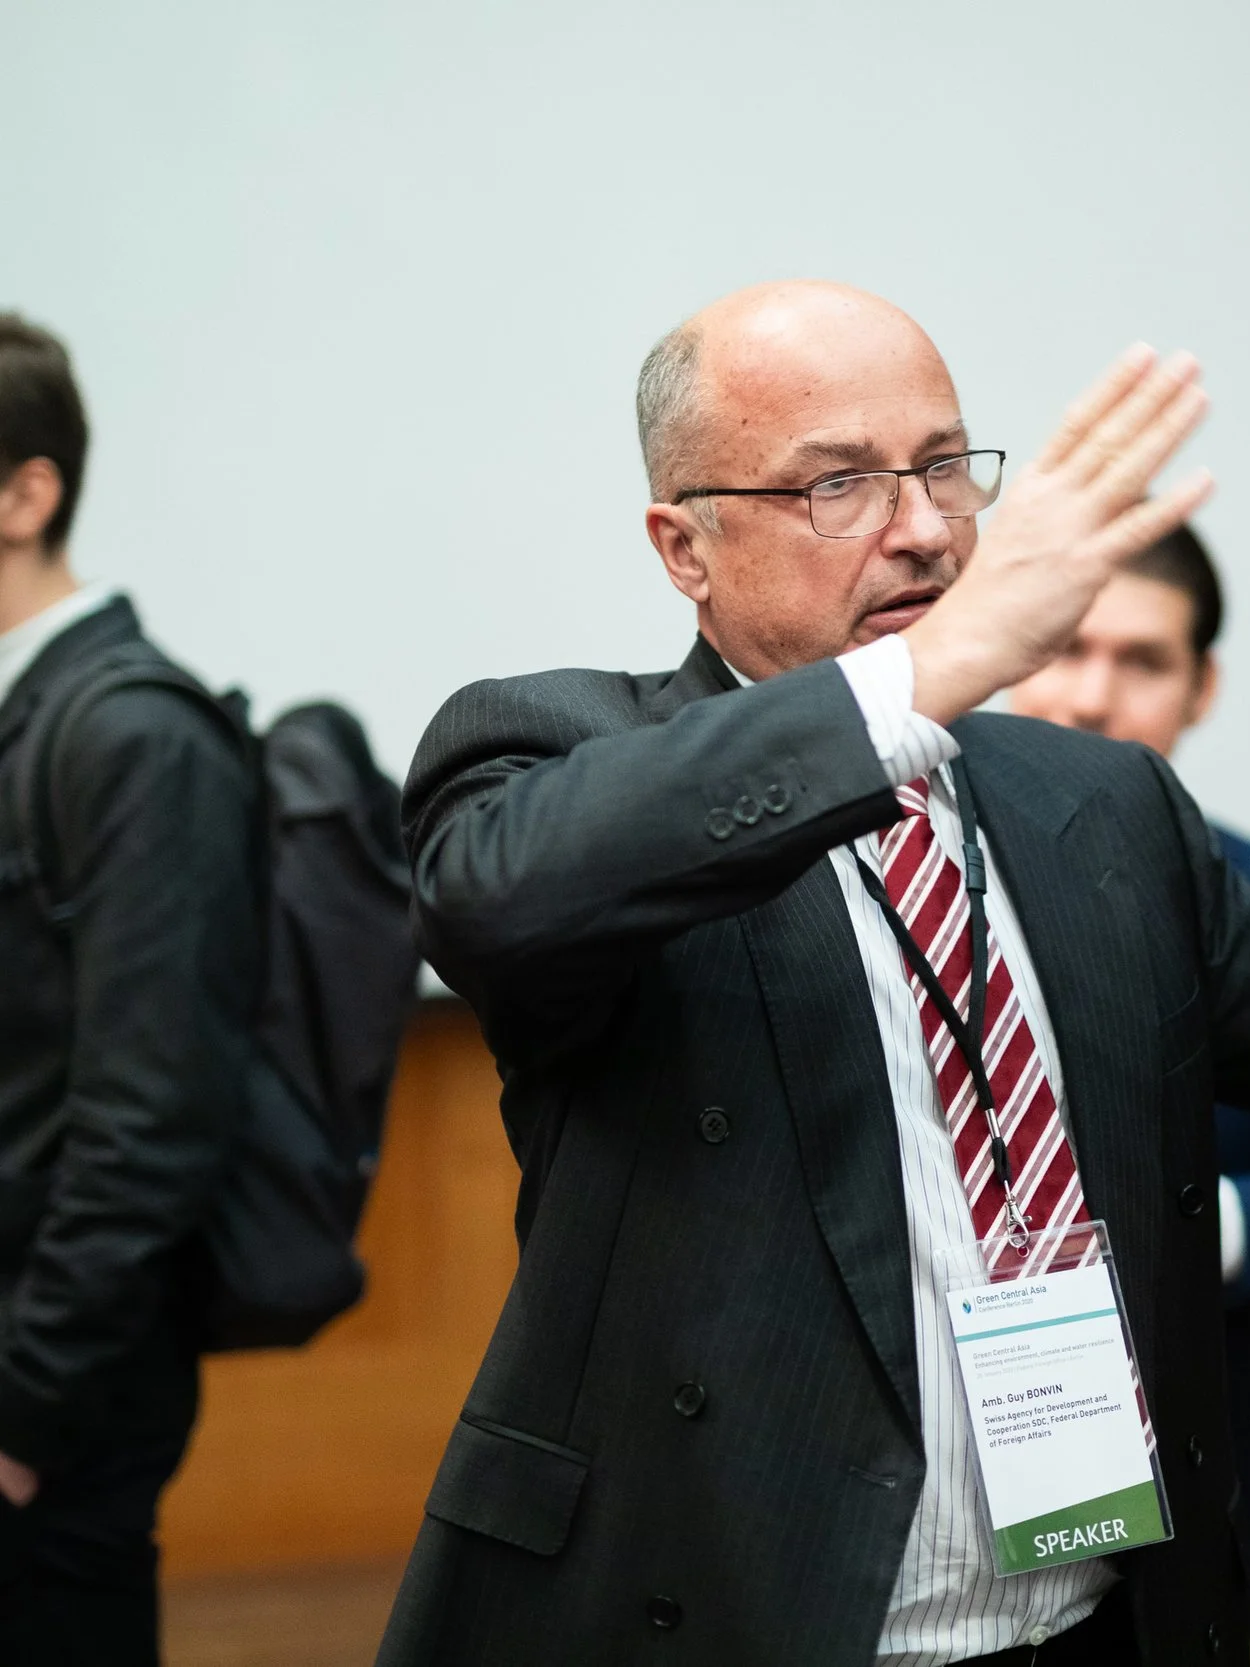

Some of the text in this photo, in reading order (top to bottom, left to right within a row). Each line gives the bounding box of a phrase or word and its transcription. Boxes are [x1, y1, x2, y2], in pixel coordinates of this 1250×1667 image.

[976, 1285, 1047, 1304] Green Central Asia
[973, 1351, 992, 1359] Green
[992, 1345, 1016, 1356] Central
[975, 1359, 1003, 1369] Enhancing
[1040, 1347, 1060, 1356] climate
[1088, 1338, 1115, 1348] resilience
[981, 1383, 1063, 1408] Amb. Guy BONVIN
[984, 1394, 1108, 1424] Swiss Agency for Development and
[986, 1403, 1122, 1436] Cooperation SDC, Federal Department
[989, 1429, 1052, 1448] of Foreign Affairs
[1033, 1517, 1129, 1558] SPEAKER
